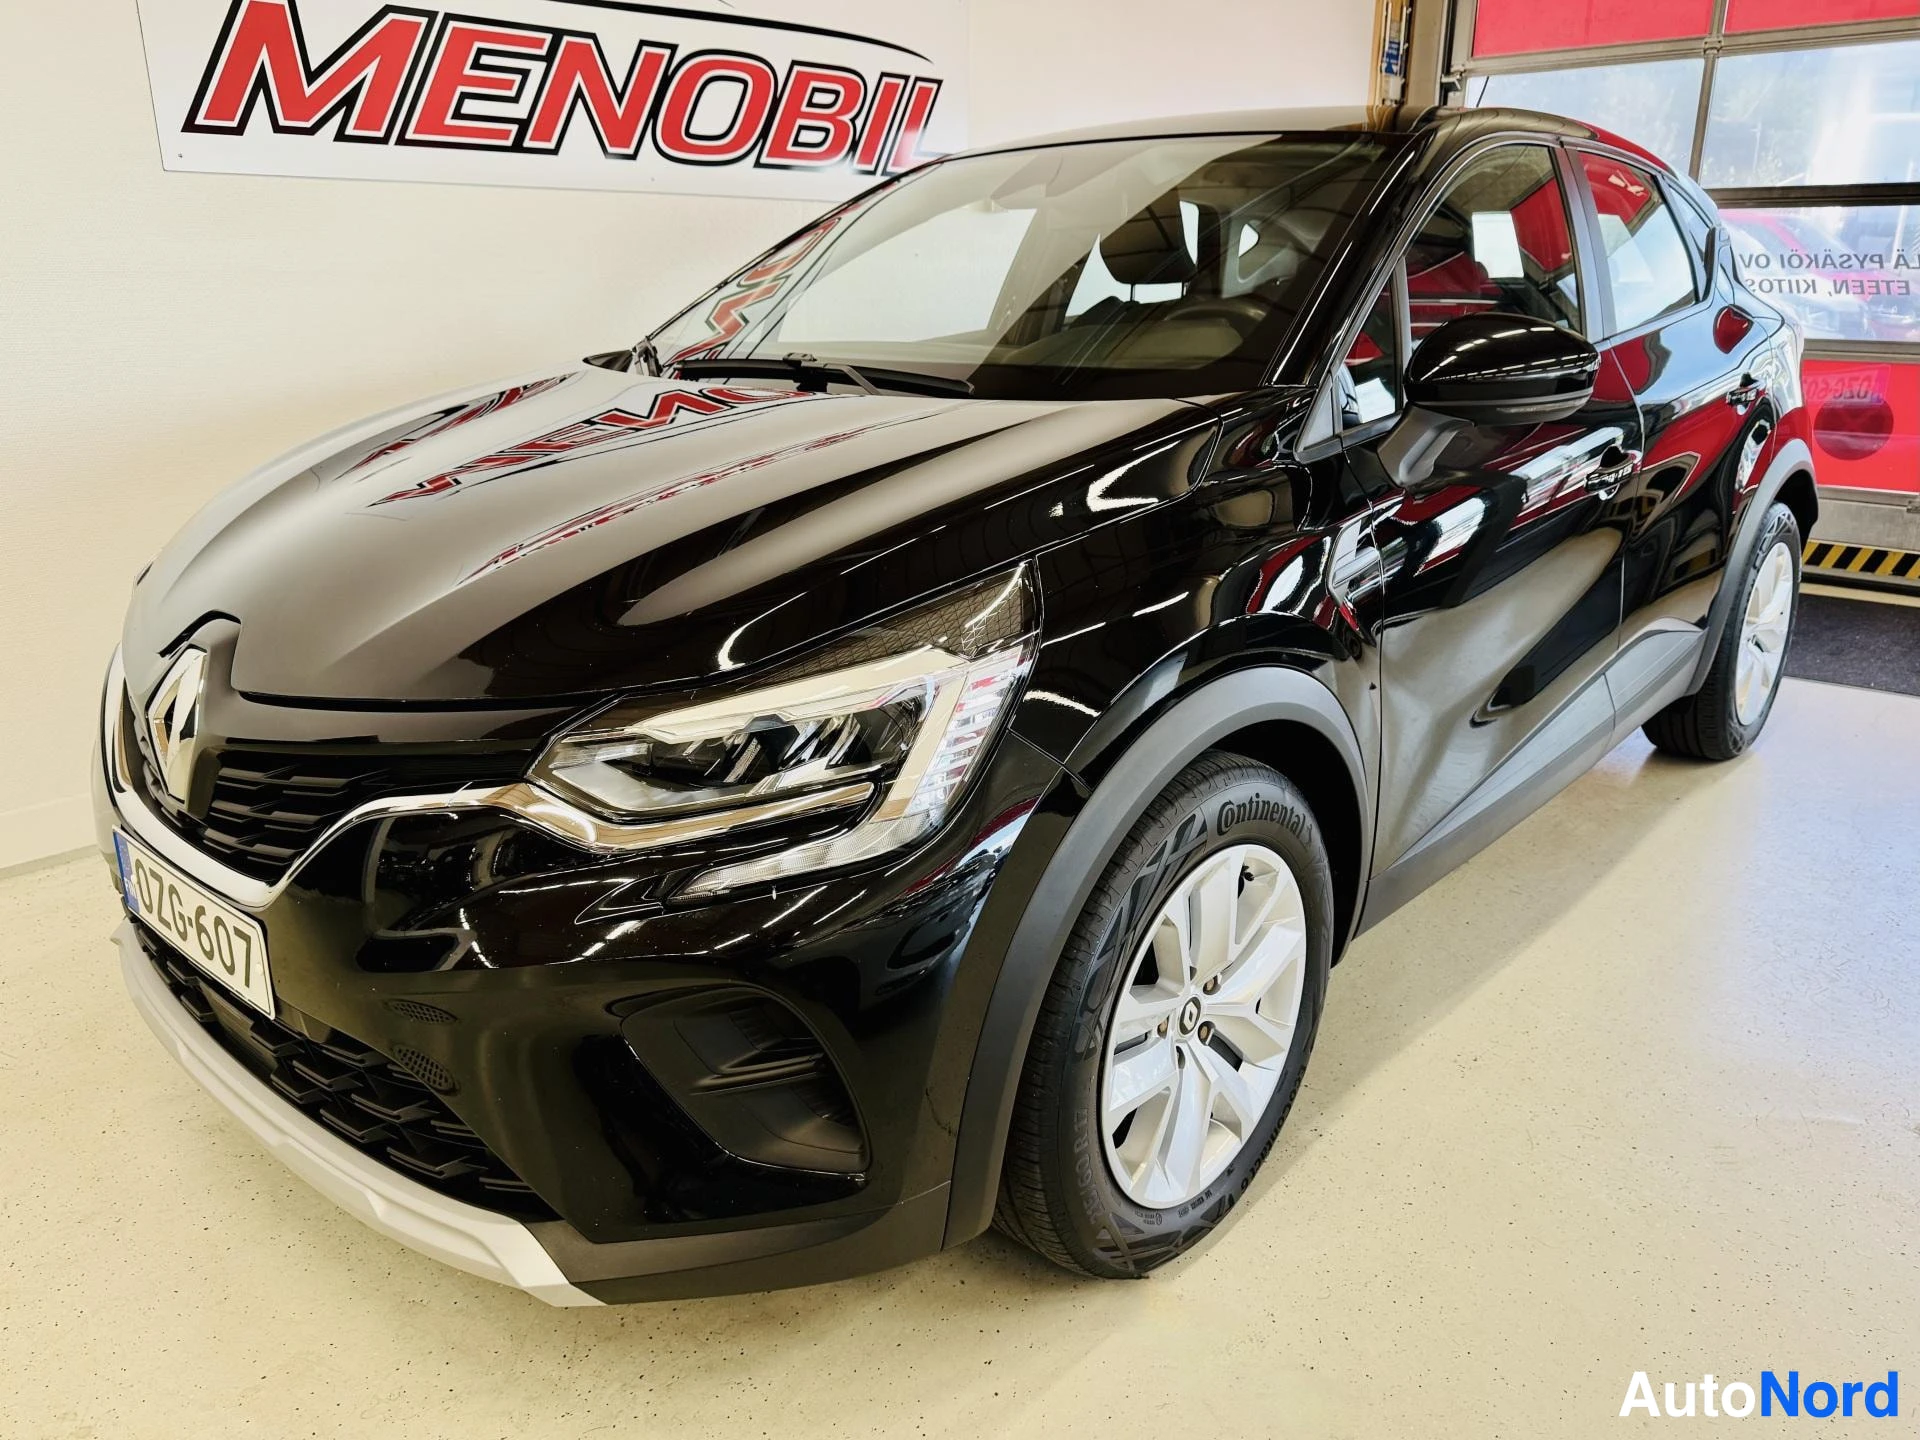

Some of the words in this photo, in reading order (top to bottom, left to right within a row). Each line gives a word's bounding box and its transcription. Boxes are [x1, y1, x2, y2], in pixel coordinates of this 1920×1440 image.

[181, 0, 953, 177] MENOBIL
[1216, 792, 1306, 839] Continental
[134, 858, 252, 988] OZG-607
